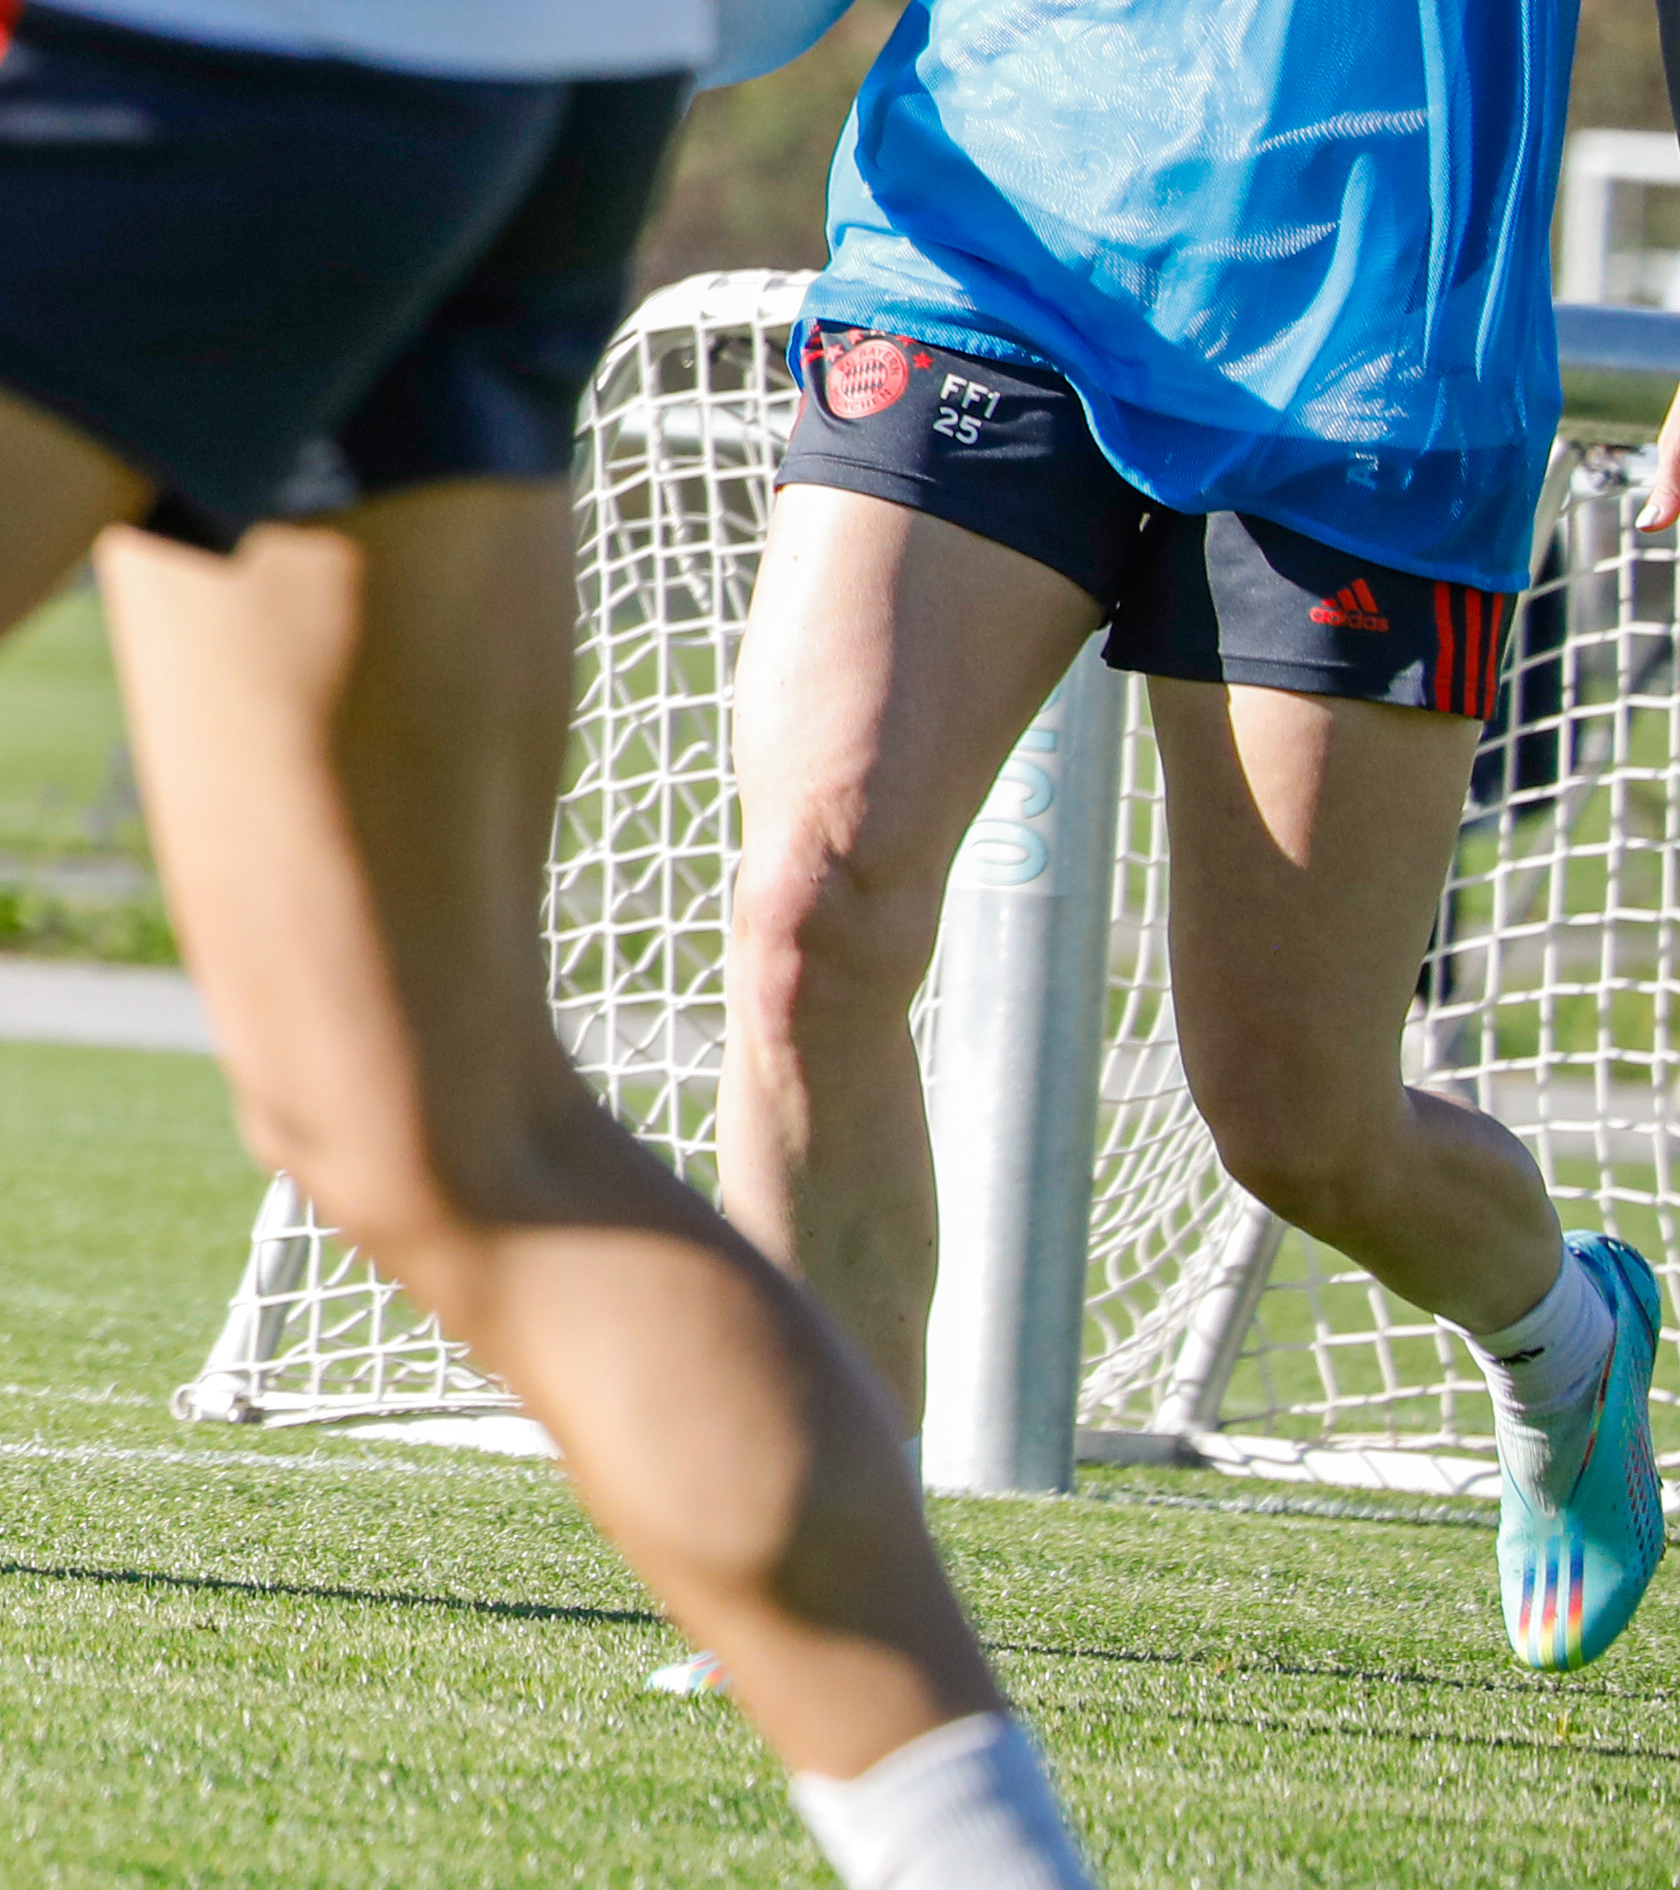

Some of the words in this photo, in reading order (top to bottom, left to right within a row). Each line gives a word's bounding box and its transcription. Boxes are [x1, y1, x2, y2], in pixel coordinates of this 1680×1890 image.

[939, 372, 1002, 420] FF1
[932, 405, 983, 446] 25
[1308, 605, 1390, 633] adidas
